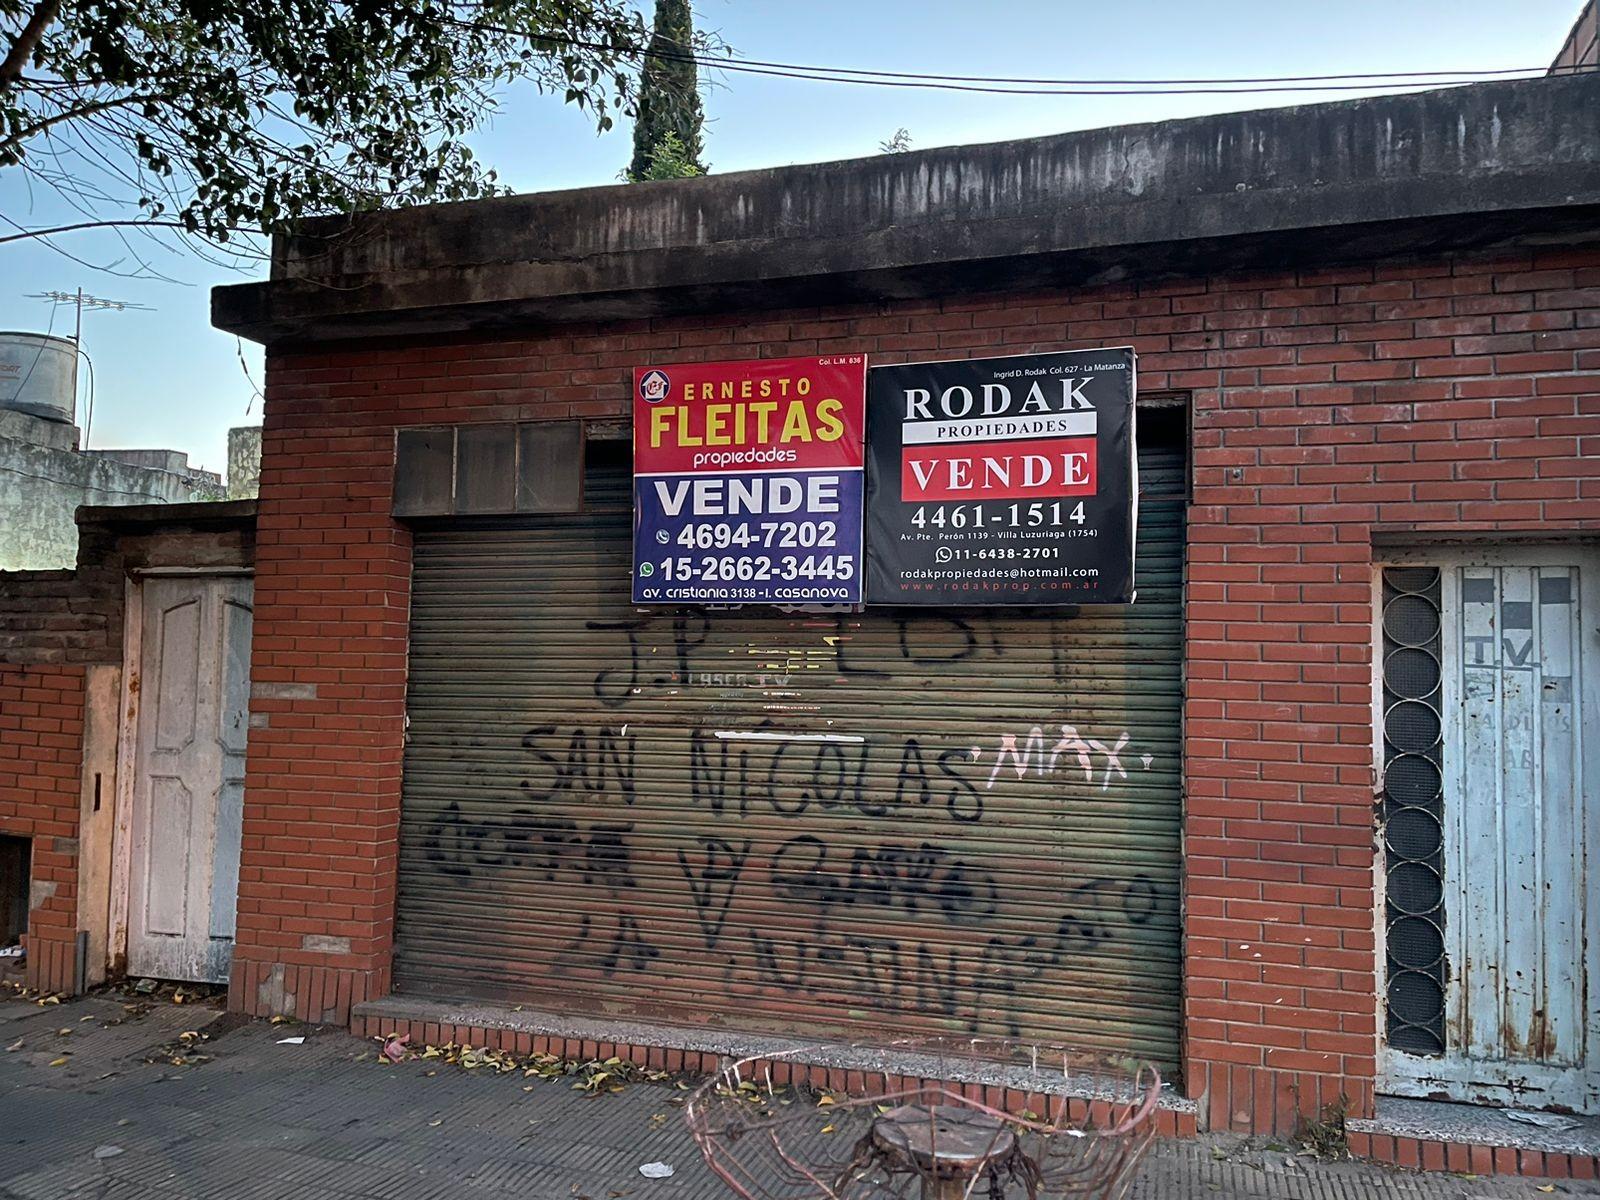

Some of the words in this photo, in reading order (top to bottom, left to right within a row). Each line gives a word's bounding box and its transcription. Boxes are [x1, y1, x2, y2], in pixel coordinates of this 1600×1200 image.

[993, 370, 1015, 380] Ingrid
[1015, 369, 1024, 377] D.
[1024, 367, 1047, 377] Rodak
[1049, 366, 1063, 375] Col.
[1064, 365, 1079, 374] 627
[1084, 364, 1093, 372] La
[1094, 362, 1126, 372] Matanza
[683, 377, 811, 400] ERNESTO
[903, 376, 1097, 421] RODAK
[650, 398, 845, 448] FLEITAS
[937, 419, 1068, 439] PROPIEDADES
[693, 446, 797, 468] propiedades
[908, 452, 1091, 491] VENDE
[653, 476, 840, 516] VENDE
[911, 501, 1086, 529] 4461-1514
[677, 521, 837, 549] 4694-7202
[900, 533, 914, 541] Av.
[917, 532, 934, 541] Pte.
[938, 531, 965, 540] Perón
[967, 532, 989, 540] 1139
[997, 531, 1018, 539] Villa
[1020, 530, 1065, 540] Luzuriaga
[1068, 529, 1098, 539] (1754)
[955, 547, 1059, 560] 11-6438-2701
[660, 555, 853, 582] 15-2662-3445
[900, 567, 1099, 580] rodakpropiedades@hotmail.com
[642, 588, 662, 598] av.
[730, 588, 756, 598] 3138
[774, 587, 849, 598] casanova
[900, 581, 1099, 591] www.rodakprop.com.ar
[520, 726, 637, 804] SAN
[690, 725, 984, 822] NICOLAS
